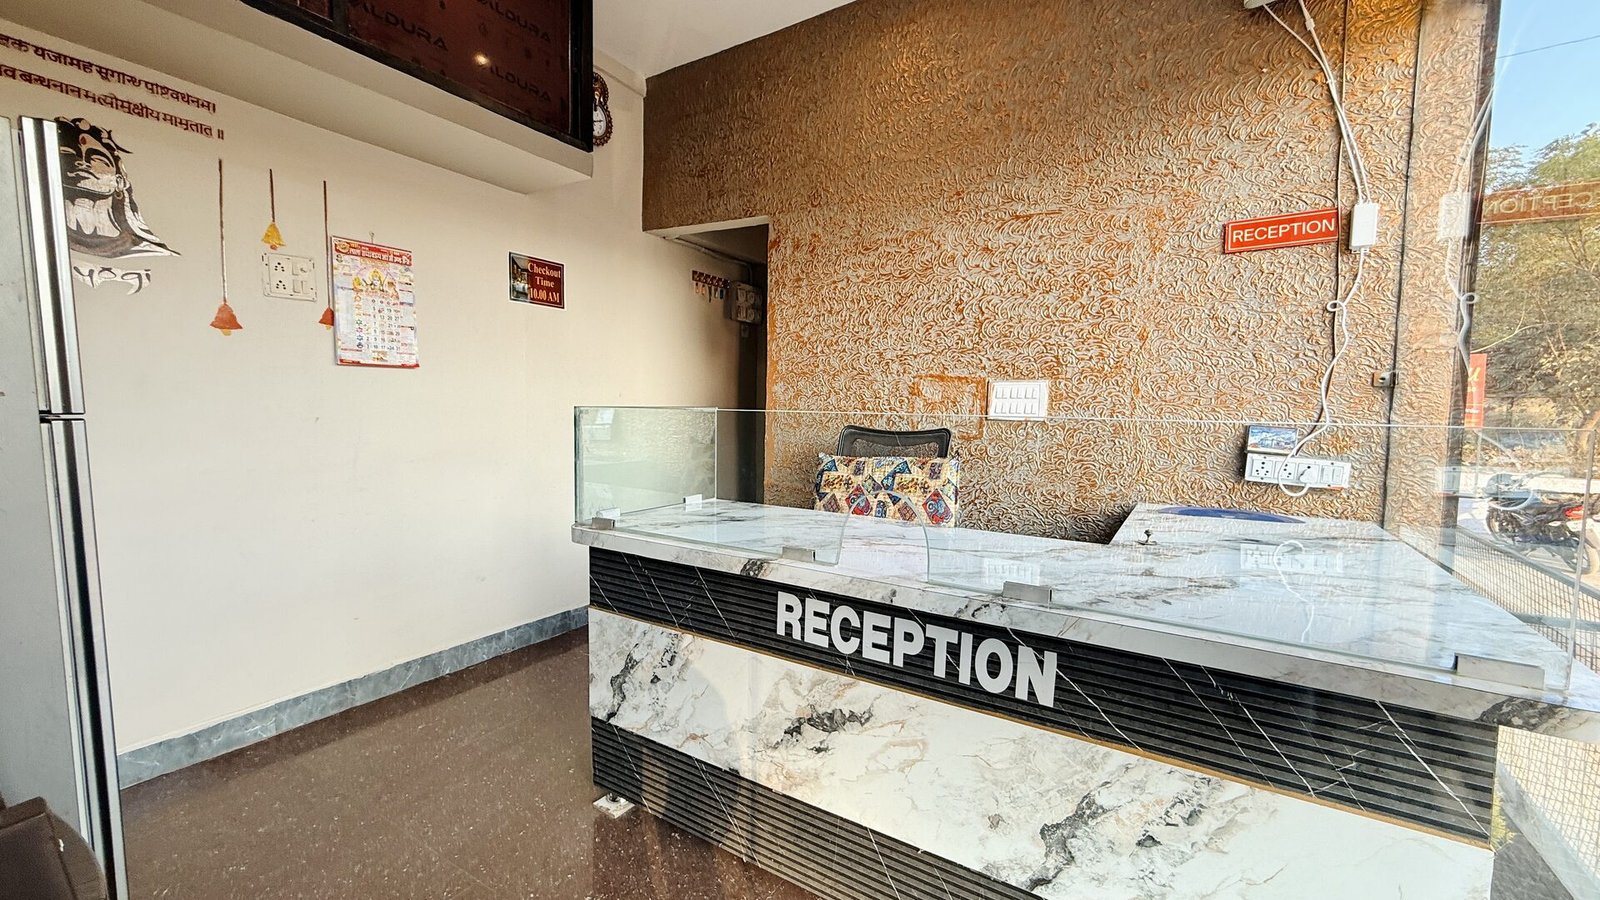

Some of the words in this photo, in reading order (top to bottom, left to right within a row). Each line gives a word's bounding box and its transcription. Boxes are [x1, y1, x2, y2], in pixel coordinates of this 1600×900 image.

[1232, 218, 1336, 243] RECEPTION
[528, 263, 561, 278] Checkout
[535, 276, 555, 288] Time
[530, 288, 547, 300] 10.00
[547, 292, 560, 302] AM
[776, 590, 1058, 707] RECEPTION
